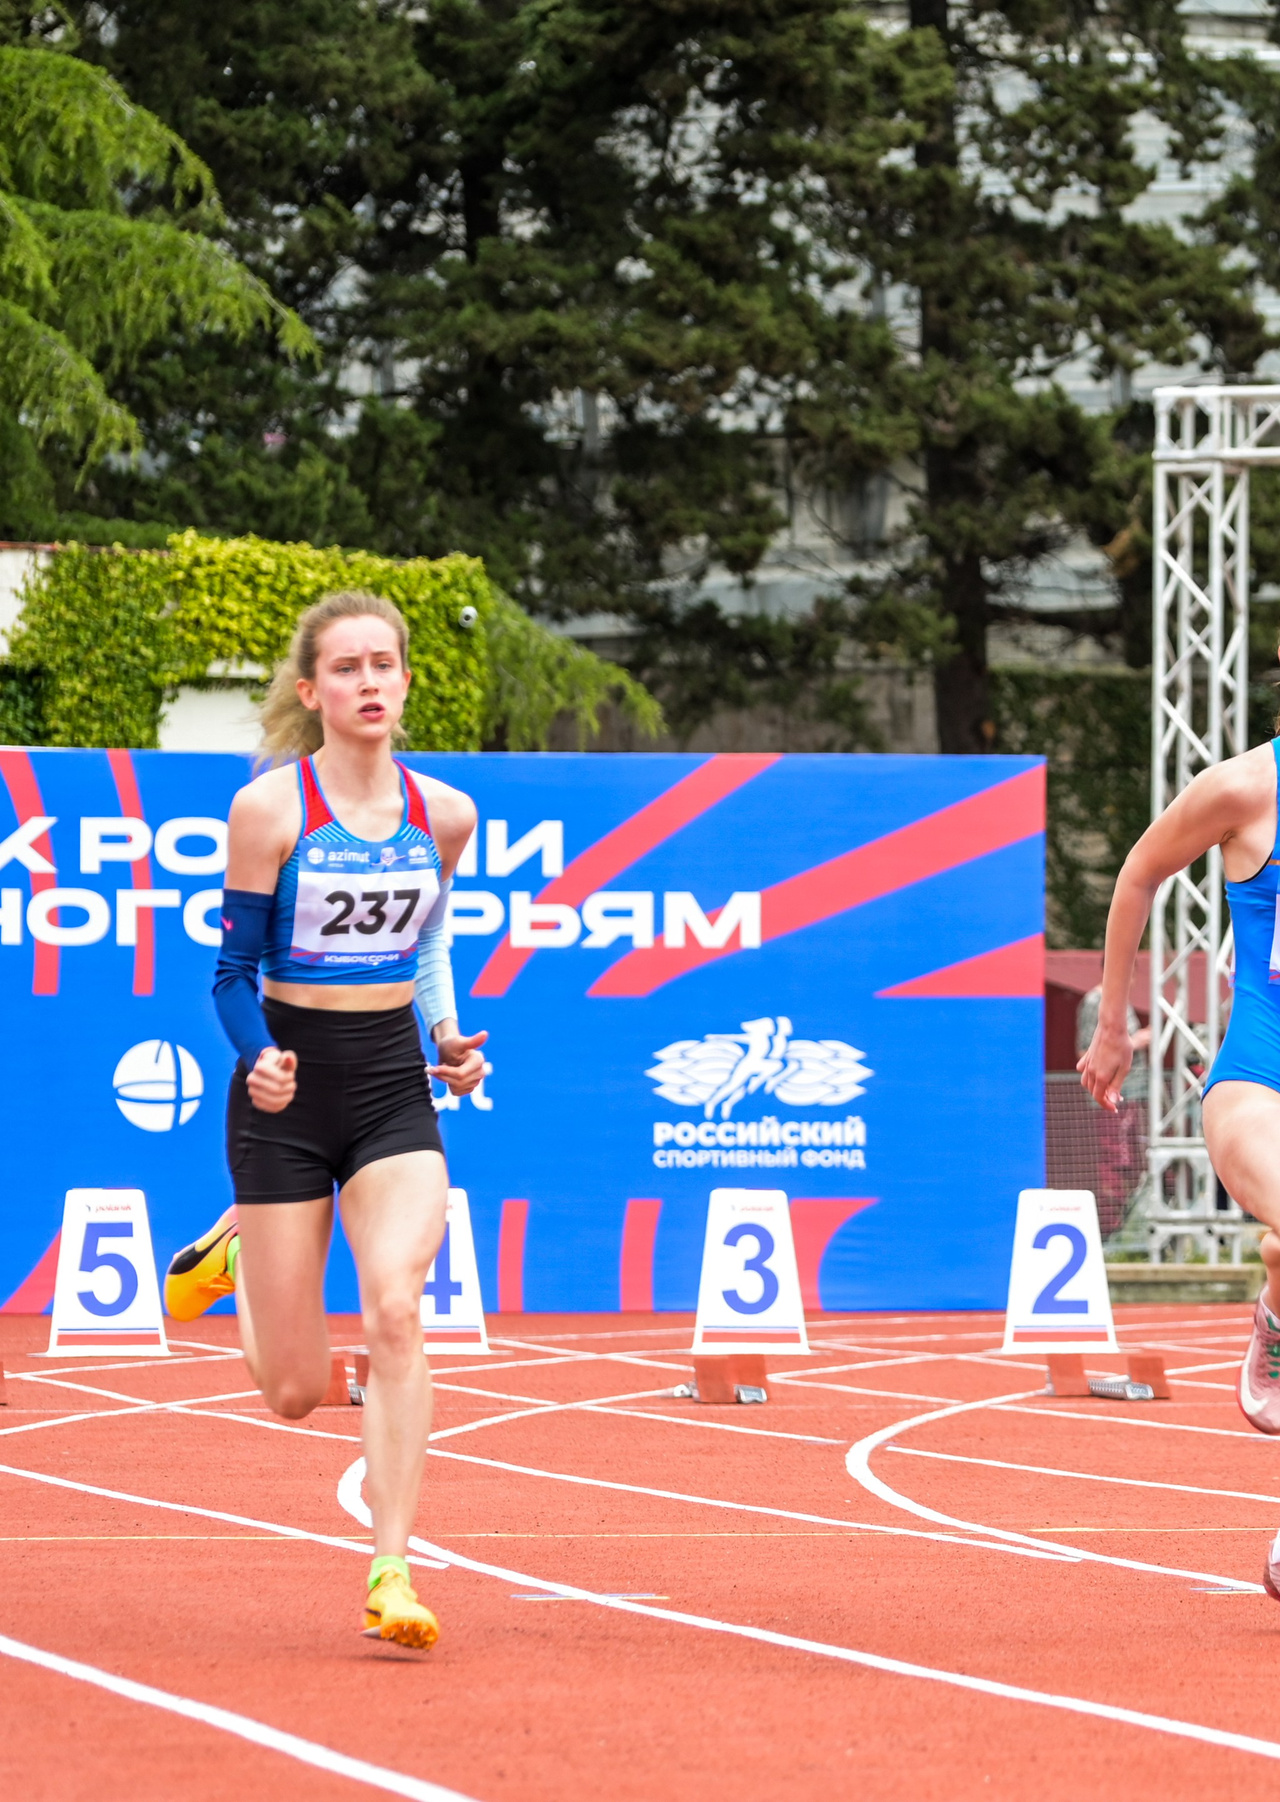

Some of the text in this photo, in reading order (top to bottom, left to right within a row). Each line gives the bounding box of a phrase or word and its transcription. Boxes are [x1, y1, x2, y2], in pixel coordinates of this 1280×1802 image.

[328, 848, 371, 863] azimut
[320, 888, 421, 937] 237
[652, 1146, 867, 1170] СПОРТИВНЫЙ ФОНД
[653, 1115, 867, 1147] РОССИЙСКИЙ
[77, 1222, 138, 1317] 5
[423, 1222, 462, 1314] 4
[722, 1223, 779, 1315] 3
[1032, 1223, 1088, 1314] 2
